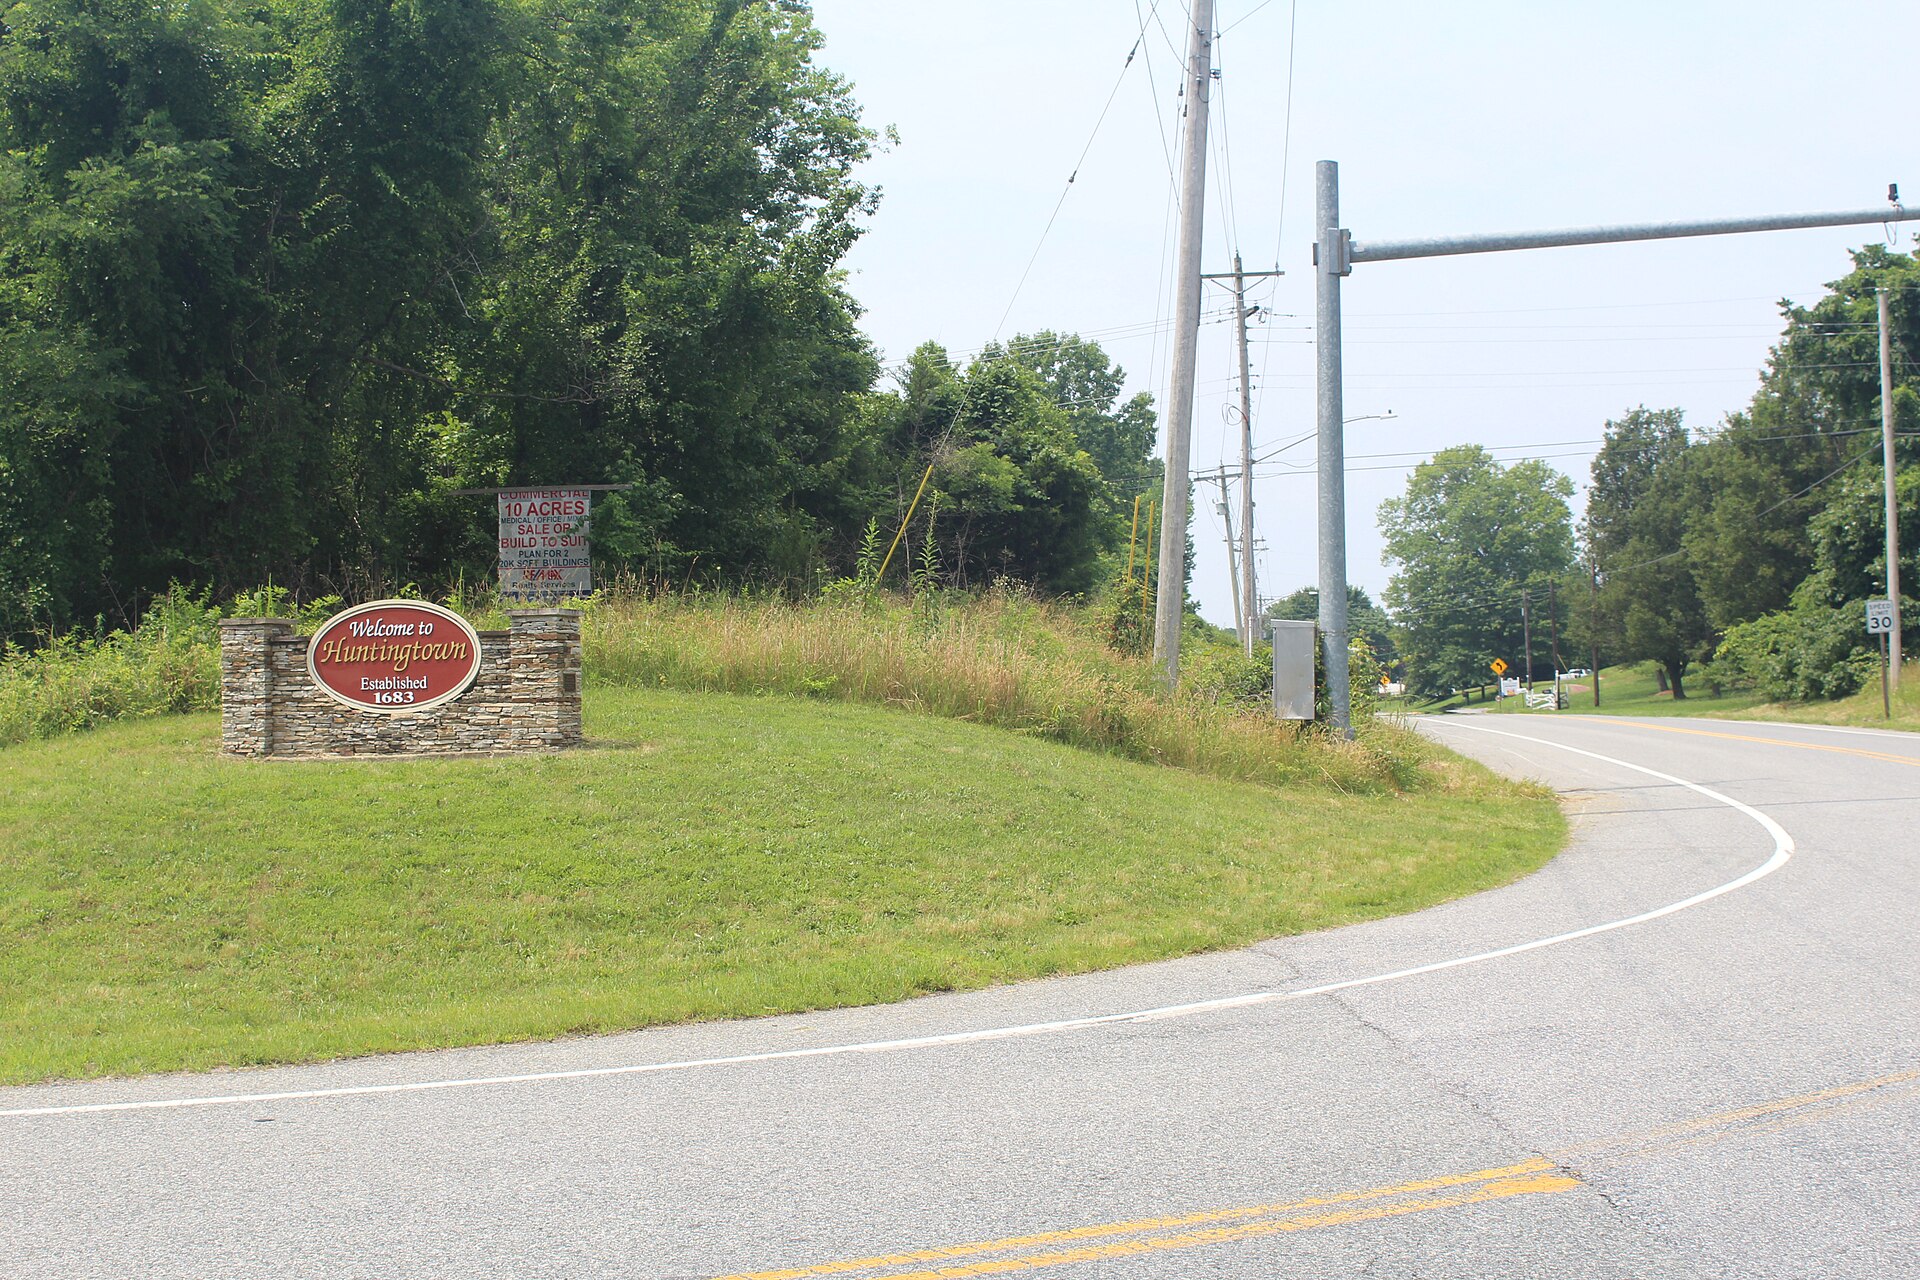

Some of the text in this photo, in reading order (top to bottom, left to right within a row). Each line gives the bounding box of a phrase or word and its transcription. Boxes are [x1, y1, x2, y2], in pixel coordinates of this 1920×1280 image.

[505, 500, 584, 517] 10 ACRES
[518, 523, 550, 535] SALE
[501, 536, 587, 548] BUILD TO SUIT
[542, 558, 588, 566] BUILDINGS
[350, 618, 433, 638] Welcome to
[1870, 616, 1892, 629] 30
[320, 636, 468, 672] Huntingtown
[360, 676, 428, 690] Established
[373, 691, 414, 704] 1683
